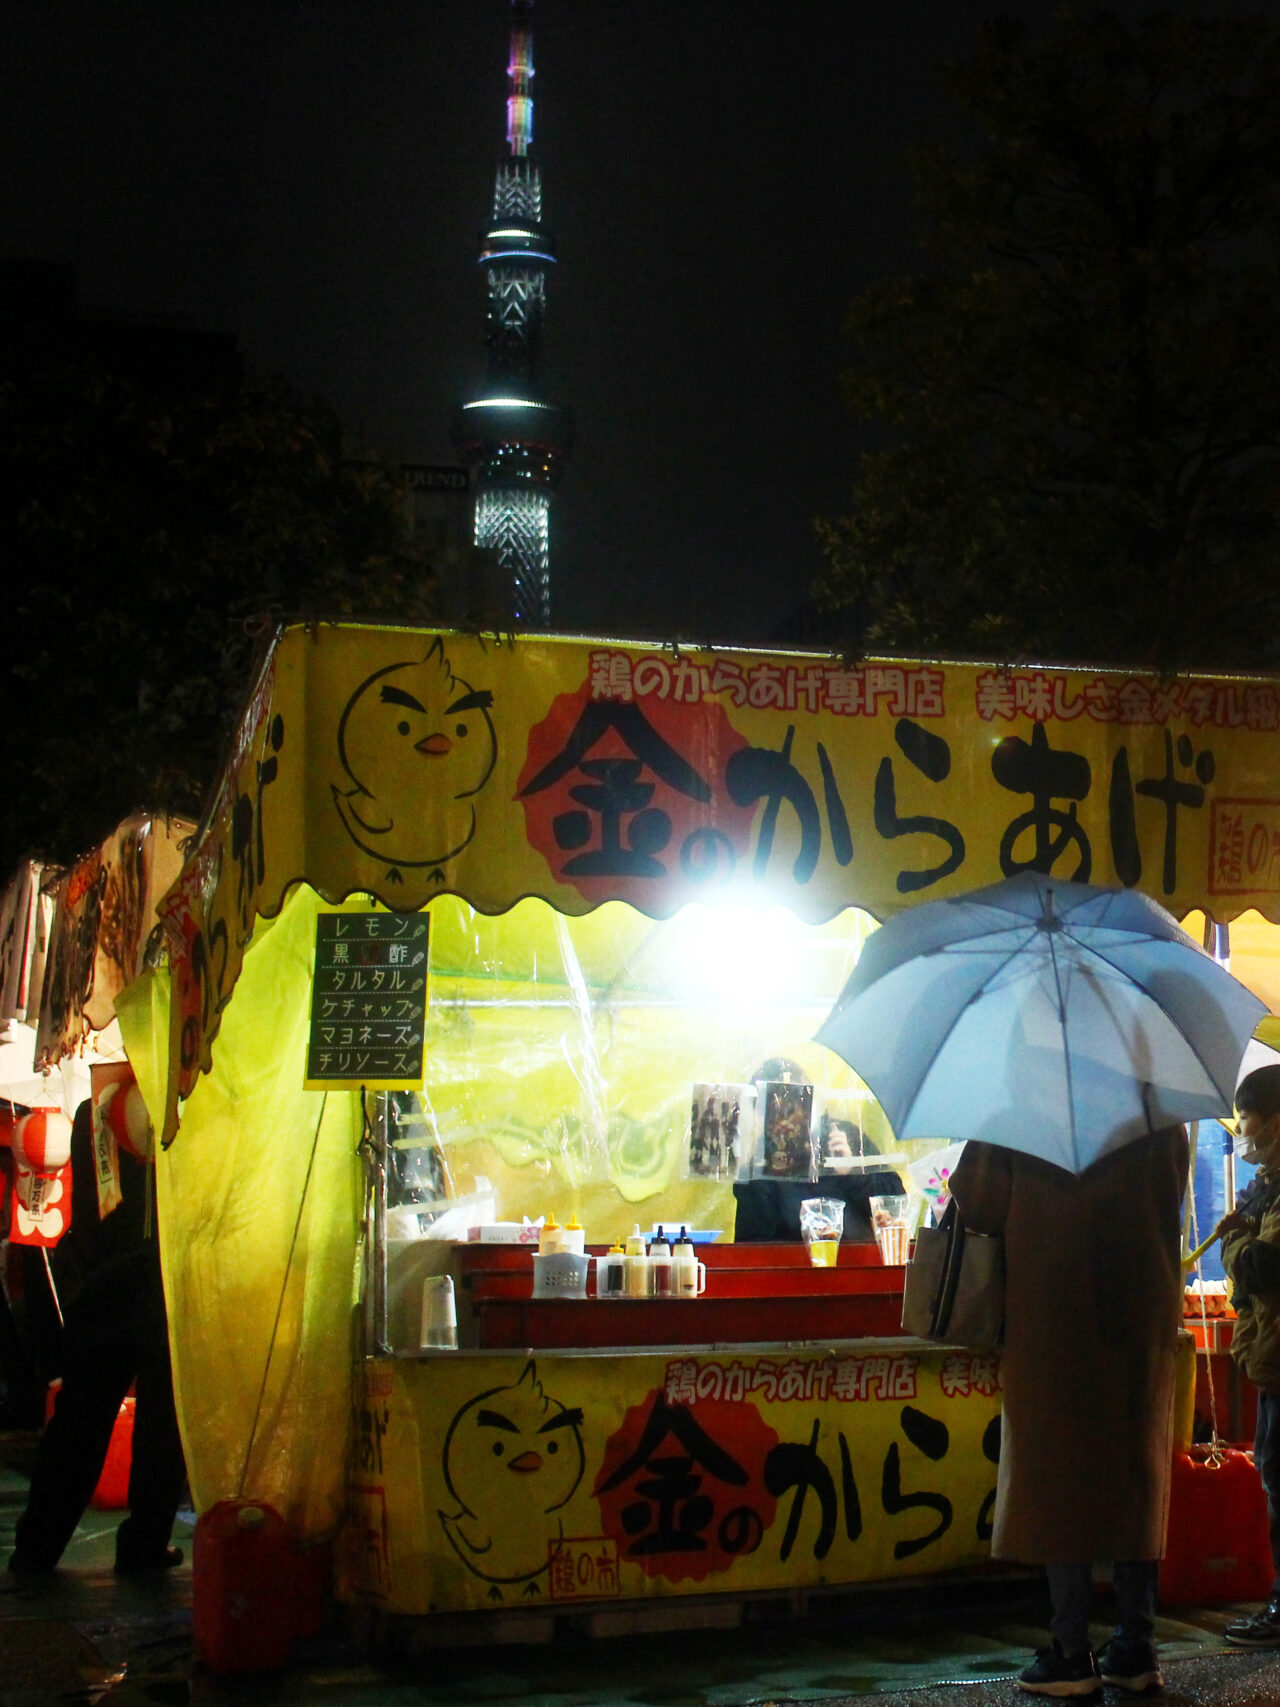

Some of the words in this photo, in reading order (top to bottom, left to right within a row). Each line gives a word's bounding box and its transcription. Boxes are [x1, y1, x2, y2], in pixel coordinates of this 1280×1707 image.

[589, 651, 945, 718] 鶏のからあげ専門店
[520, 700, 1216, 896] 金のからあげ
[336, 917, 409, 937] レモン
[332, 943, 408, 964] 黒酢
[332, 969, 406, 990] タルタル
[321, 999, 414, 1017] ケチャップ
[321, 1025, 412, 1044] マヨネーズ
[319, 1053, 407, 1072] チリソース
[665, 1355, 919, 1406] 鶏のからあげ専門店
